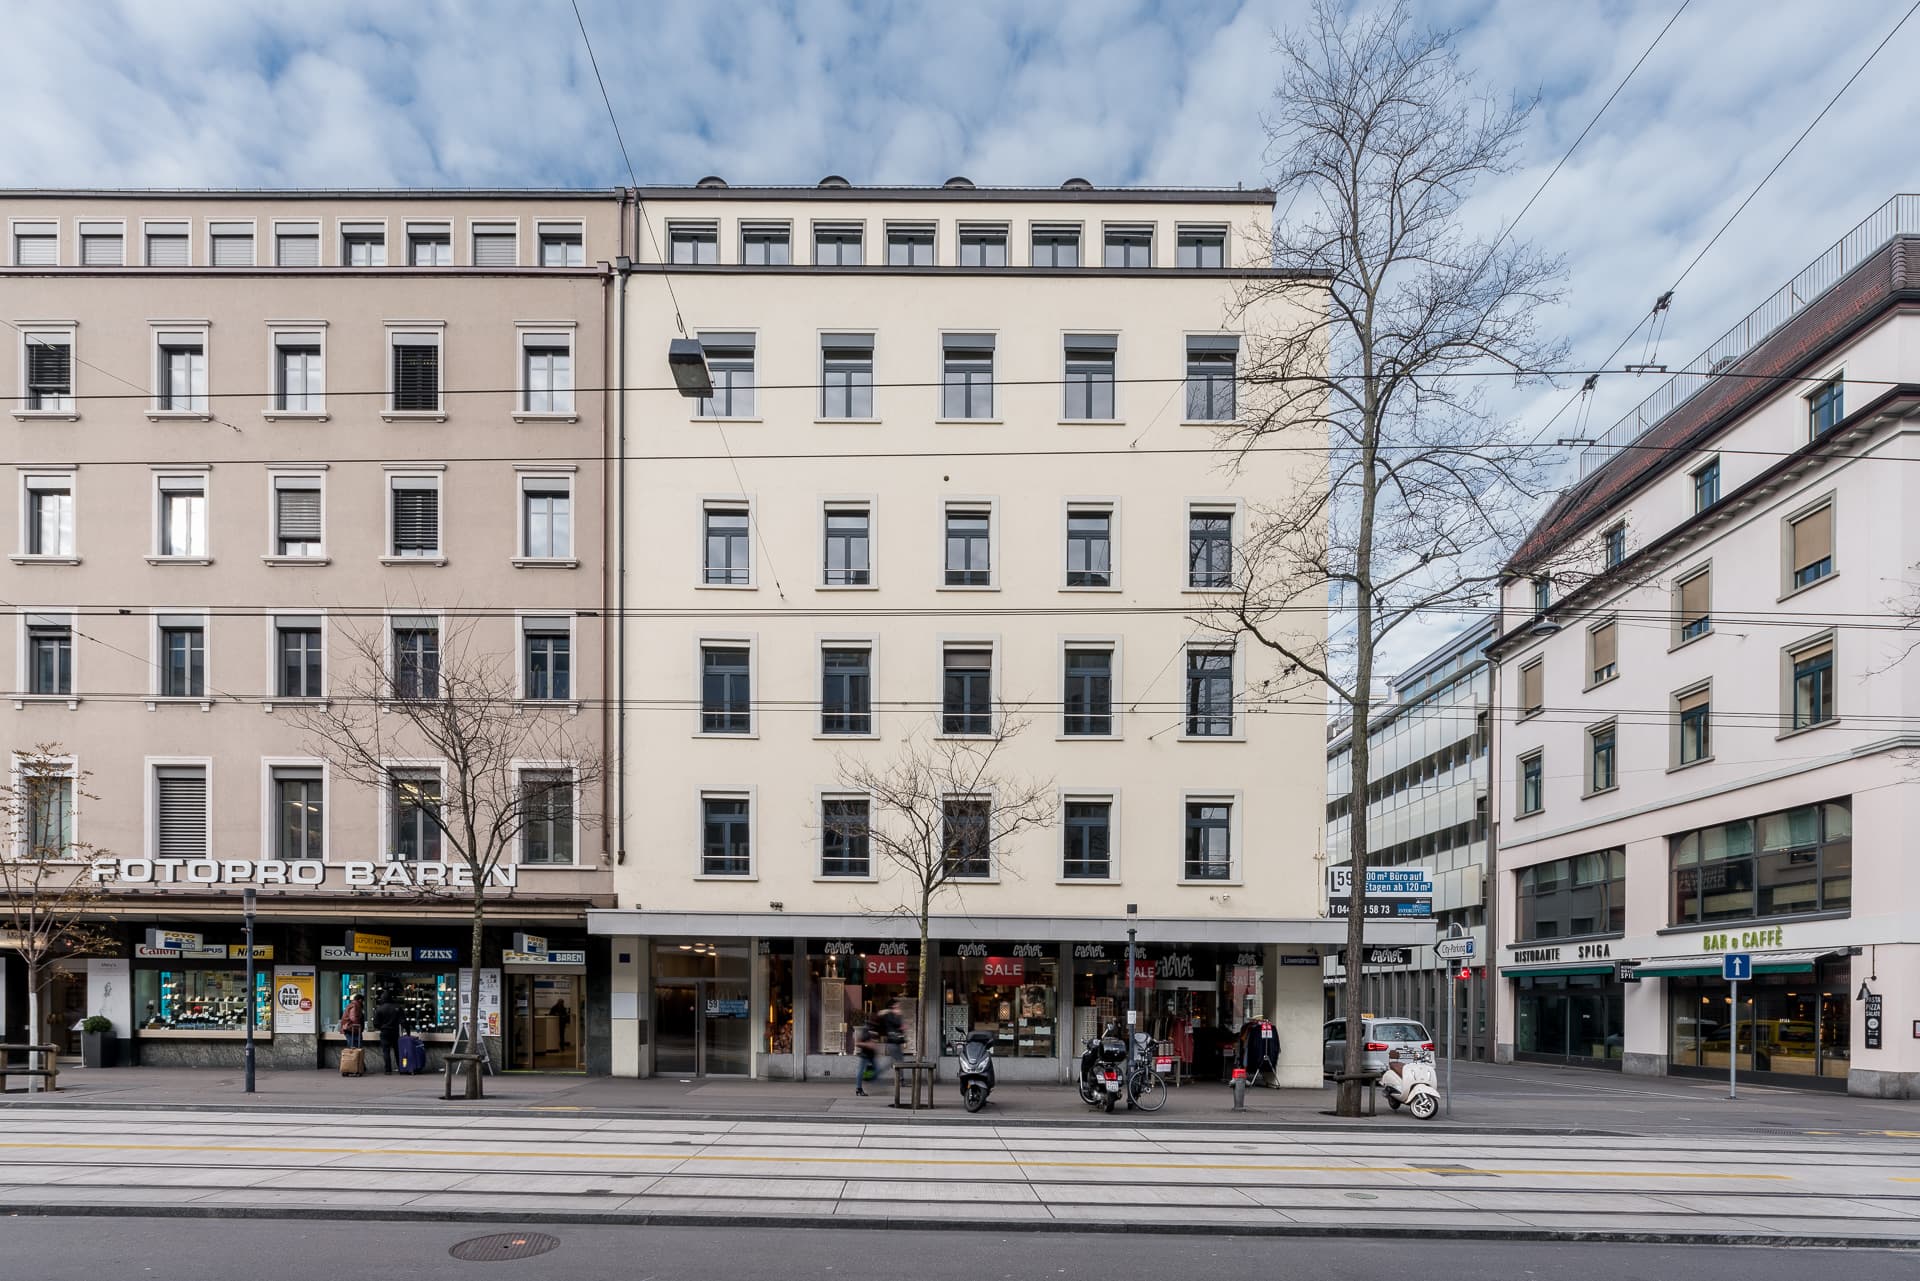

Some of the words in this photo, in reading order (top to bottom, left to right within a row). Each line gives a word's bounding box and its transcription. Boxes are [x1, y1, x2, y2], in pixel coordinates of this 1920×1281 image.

[91, 858, 324, 885] FOTOPRO
[345, 853, 517, 887] BÄREN
[1393, 883, 1403, 891] ab
[1406, 883, 1419, 891] 120
[1369, 905, 1379, 913] 58
[1381, 905, 1390, 913] 73
[1703, 934, 1727, 951] BAR
[1742, 926, 1783, 948] CAFFÈ
[139, 946, 176, 956] Canon
[237, 948, 265, 957] Nion
[420, 950, 453, 959] ZEISS
[1514, 948, 1560, 962] RISTORANTE
[1578, 944, 1610, 959] SPIGA
[868, 962, 905, 974] SALE
[985, 964, 1022, 976] SALE
